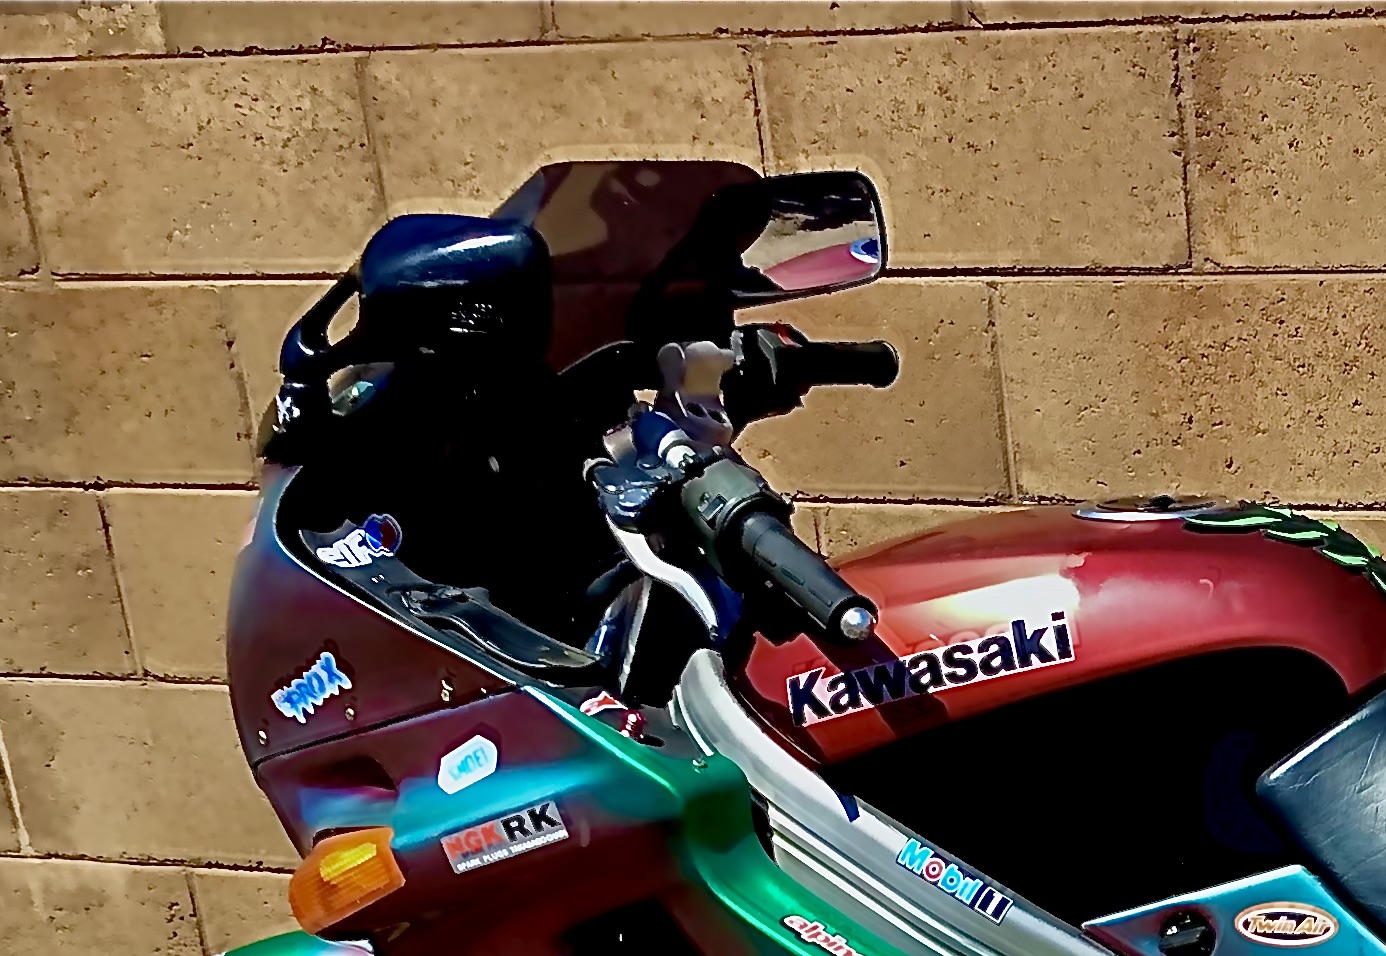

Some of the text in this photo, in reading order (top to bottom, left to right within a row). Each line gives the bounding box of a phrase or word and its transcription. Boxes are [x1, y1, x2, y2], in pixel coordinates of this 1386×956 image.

[788, 610, 1073, 727] Kawasaki
[444, 803, 562, 859] NGK RK
[897, 838, 984, 905] Mobil
[1248, 915, 1330, 935] Twin Air
